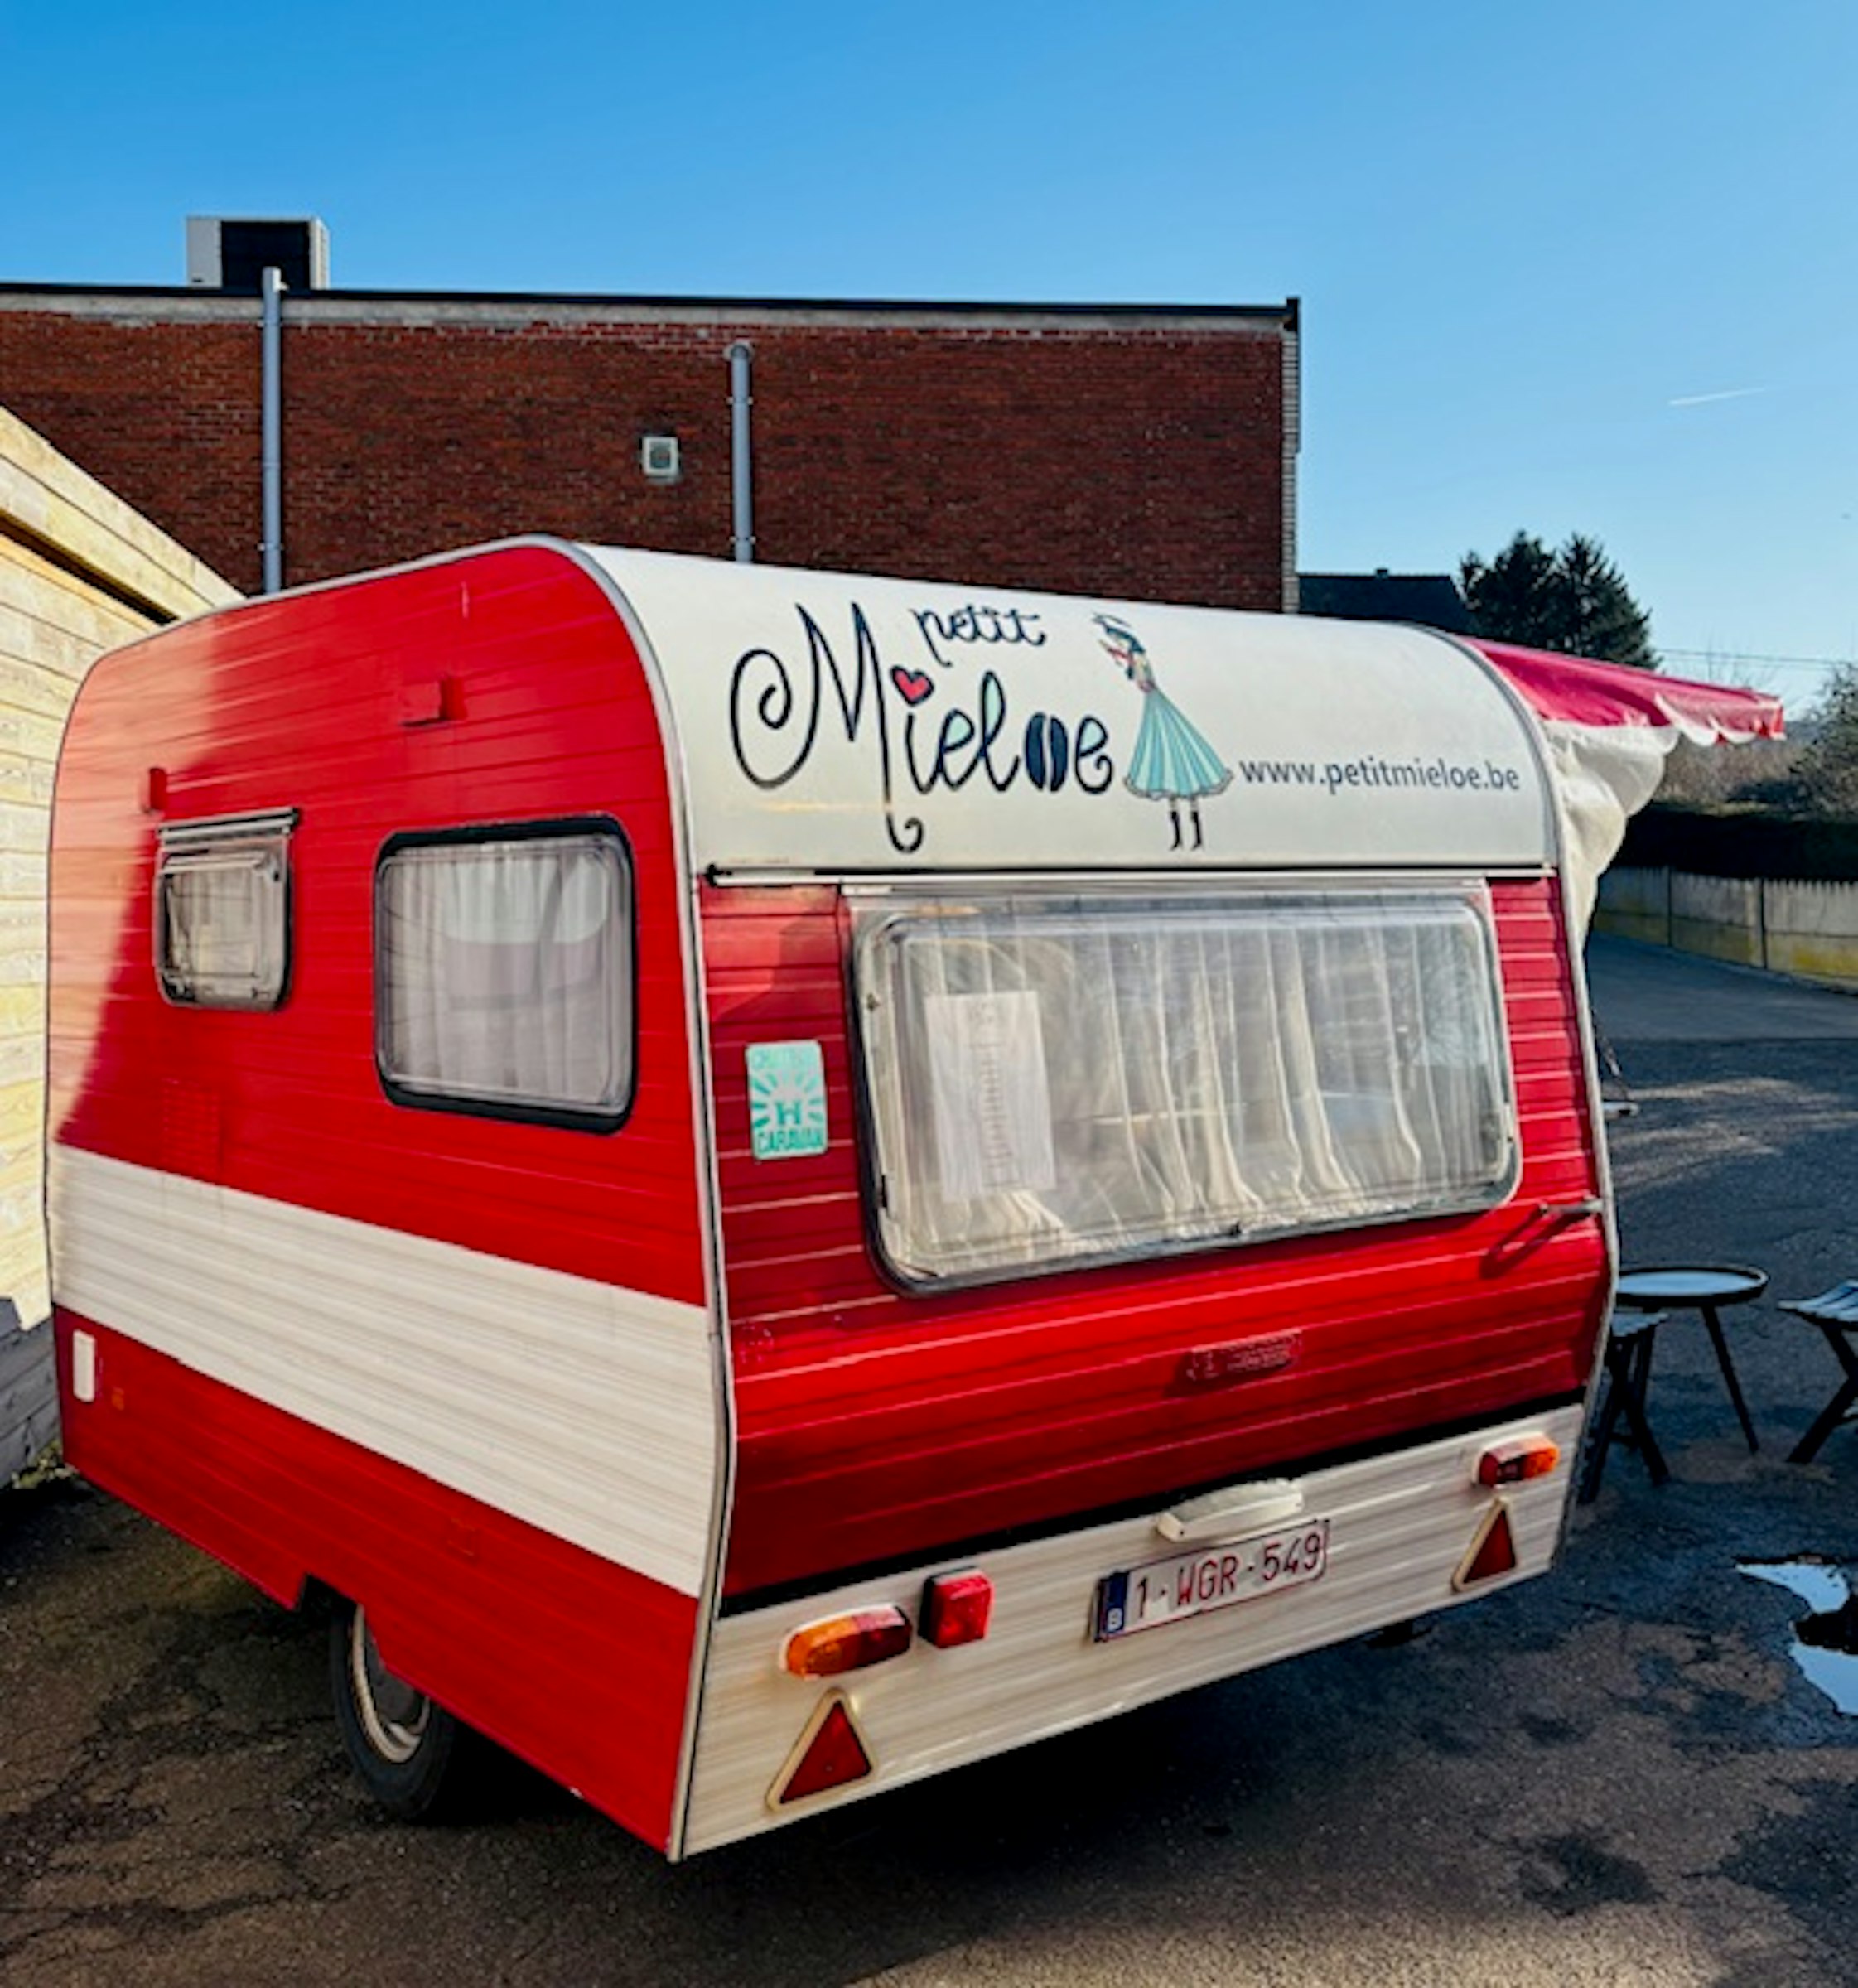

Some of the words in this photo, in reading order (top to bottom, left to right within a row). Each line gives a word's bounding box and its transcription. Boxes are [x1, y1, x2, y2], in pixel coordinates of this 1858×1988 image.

[910, 605, 1047, 667] petit
[730, 601, 1113, 853] Mieloe
[1239, 755, 1521, 795] www.petitmieloe.be
